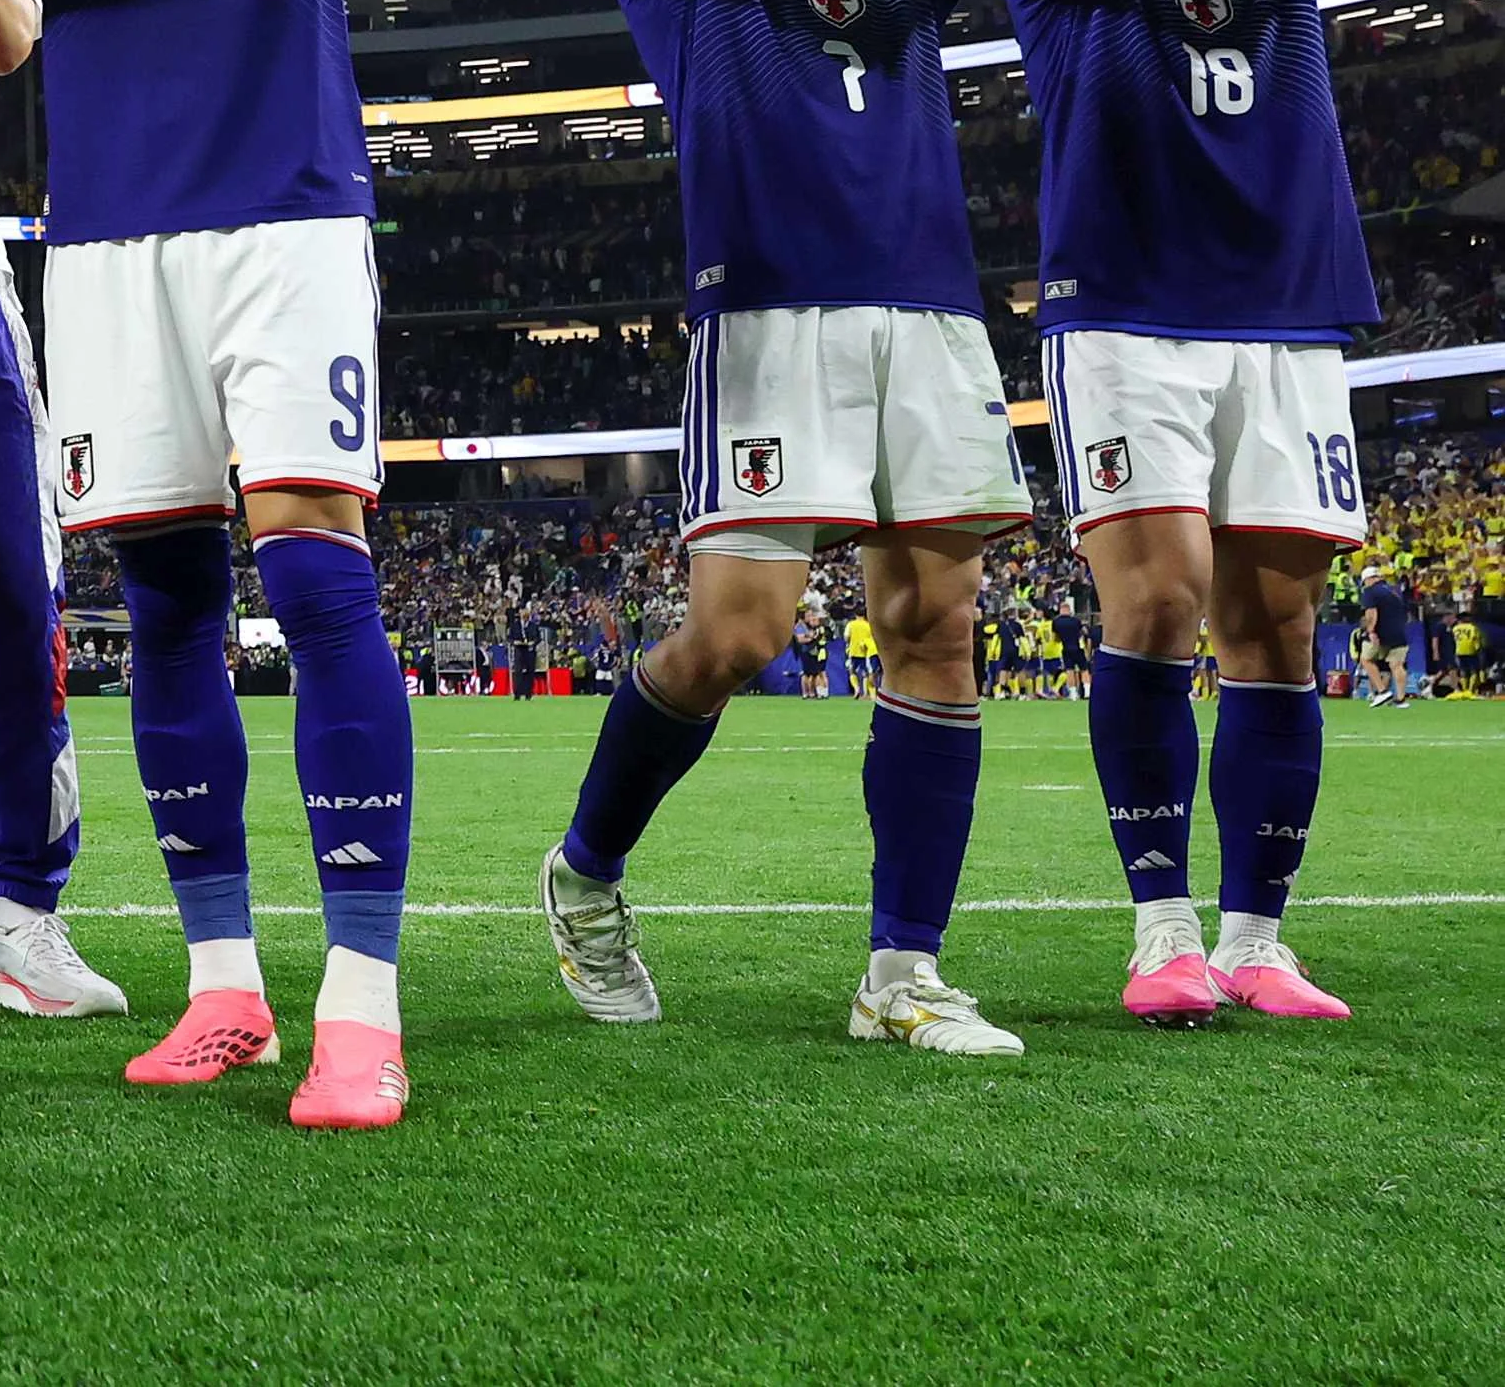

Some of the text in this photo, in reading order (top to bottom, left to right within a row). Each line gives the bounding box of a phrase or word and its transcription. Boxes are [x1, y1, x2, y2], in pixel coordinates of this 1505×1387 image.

[822, 39, 866, 112] 7
[1182, 41, 1254, 116] 18
[329, 355, 365, 452] 9
[1307, 431, 1358, 512] 18
[144, 782, 209, 801] PAN
[306, 793, 403, 809] JAPAN
[1109, 803, 1184, 821] JAPAN
[1256, 823, 1309, 841] JAP
